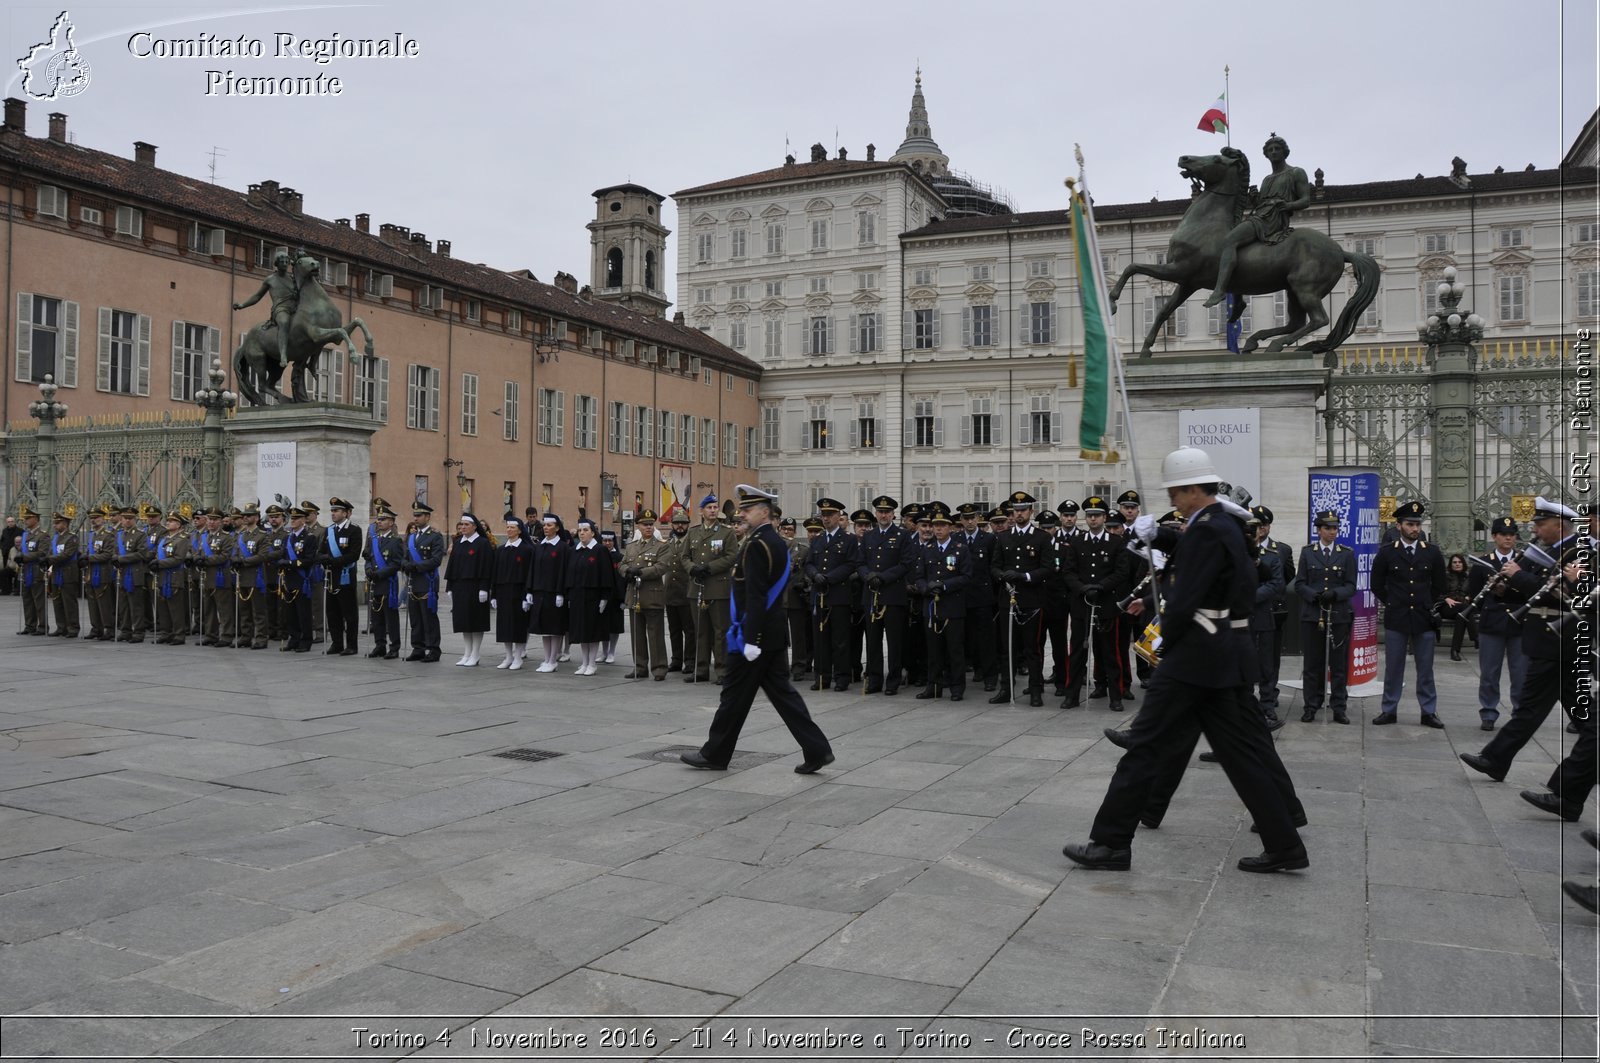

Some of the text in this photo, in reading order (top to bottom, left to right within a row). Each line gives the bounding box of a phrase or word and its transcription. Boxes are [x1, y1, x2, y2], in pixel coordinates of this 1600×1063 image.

[1188, 423, 1251, 434] POLO REALE
[1187, 435, 1233, 445] TORINO
[261, 453, 276, 461] POLO
[261, 461, 283, 469] TORINO
[1355, 526, 1360, 544] E
